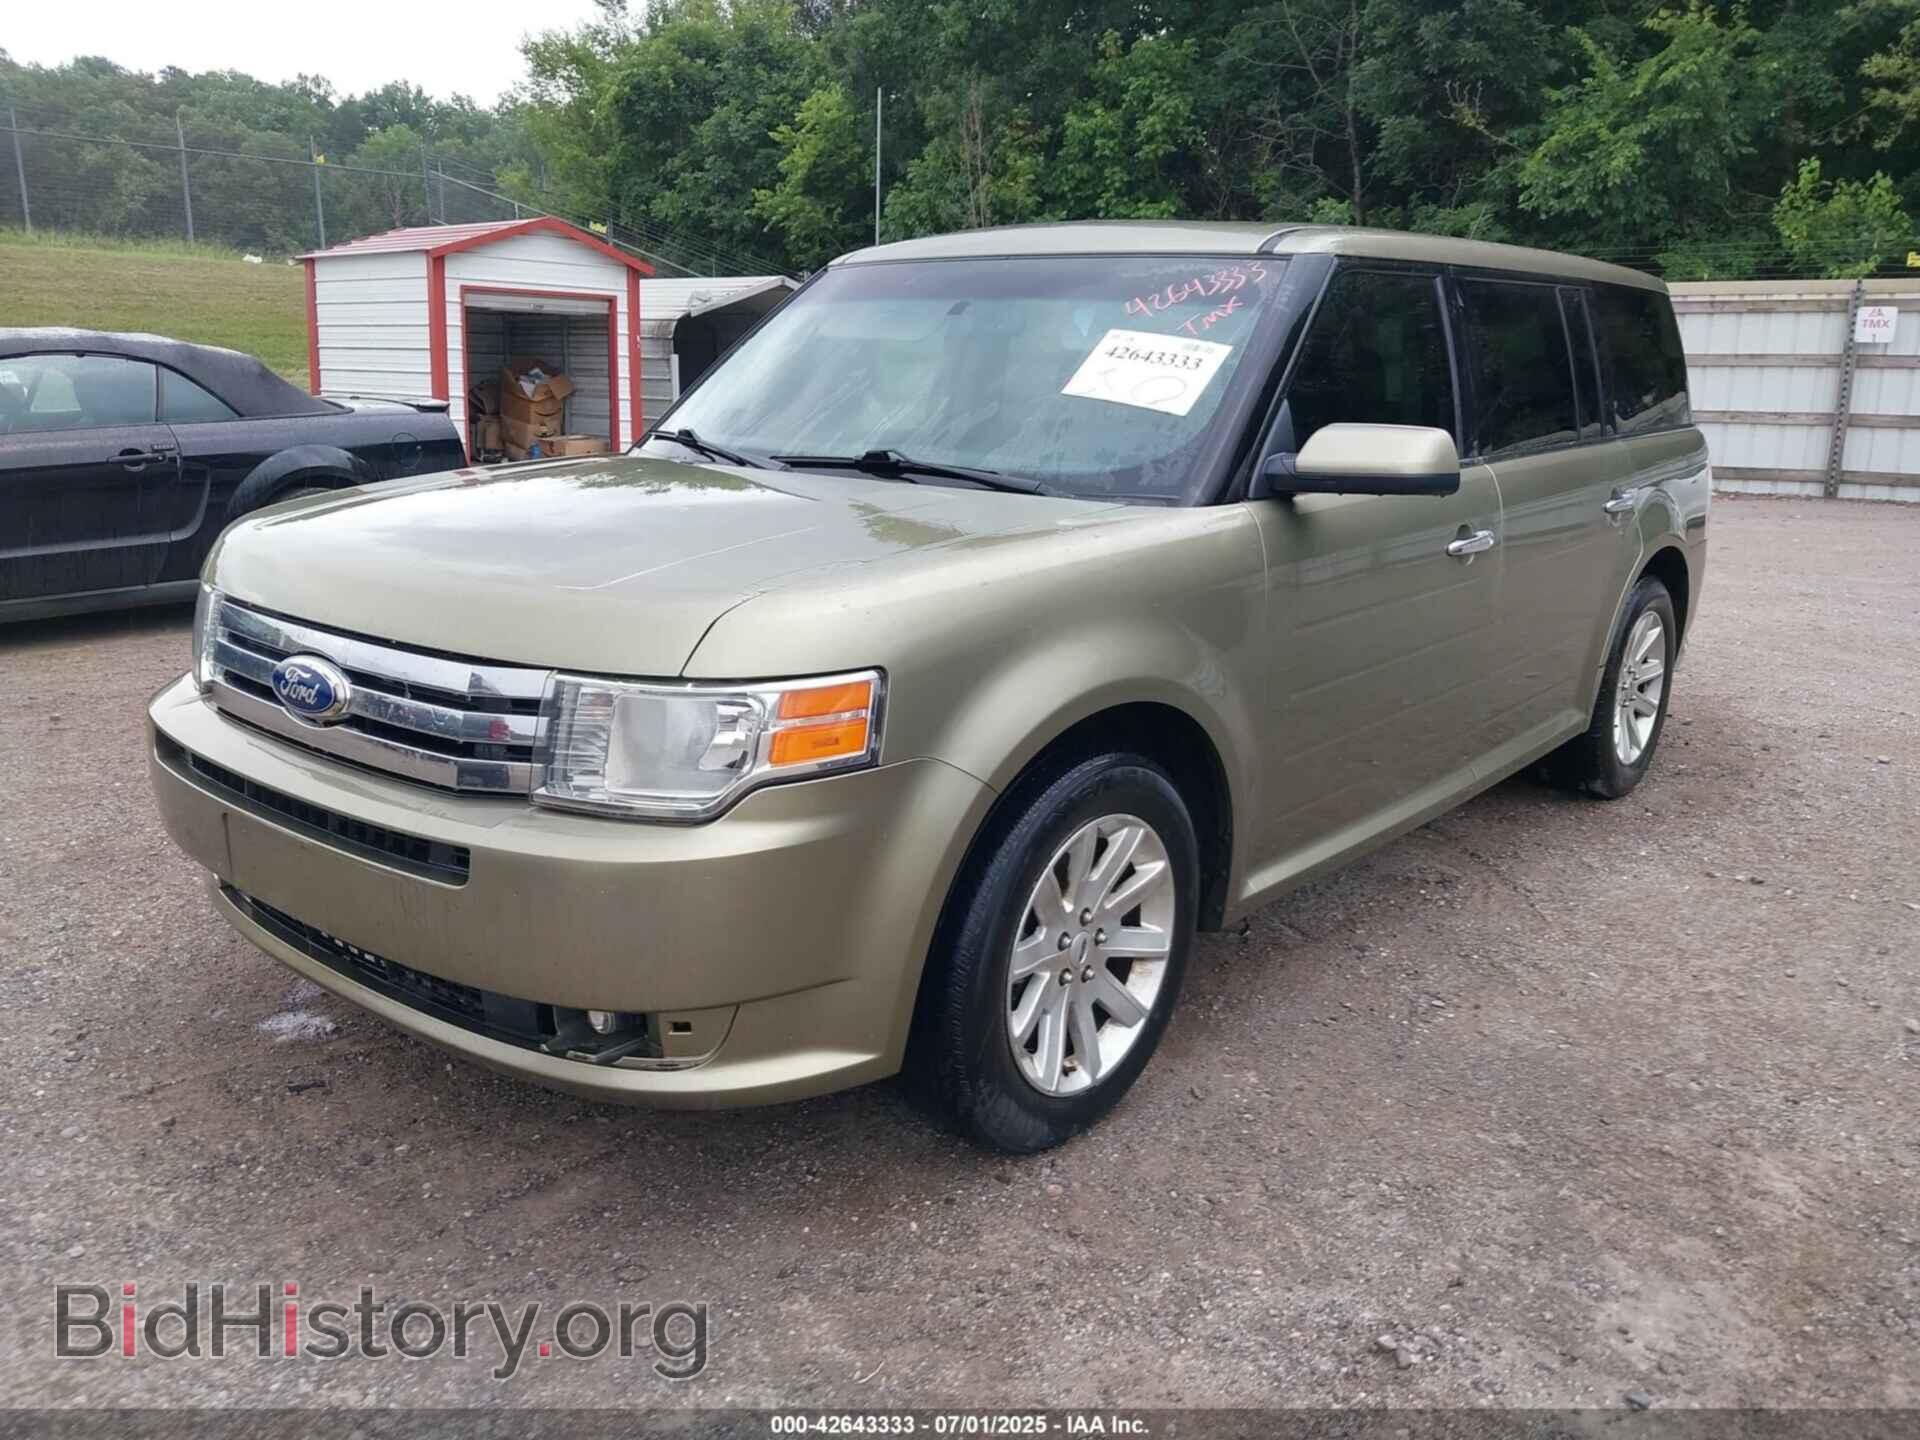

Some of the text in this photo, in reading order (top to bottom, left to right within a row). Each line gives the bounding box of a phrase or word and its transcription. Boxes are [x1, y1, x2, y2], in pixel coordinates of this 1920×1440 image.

[1863, 319, 1890, 329] TMX
[1103, 345, 1204, 371] 42643333
[280, 666, 321, 705] Ford
